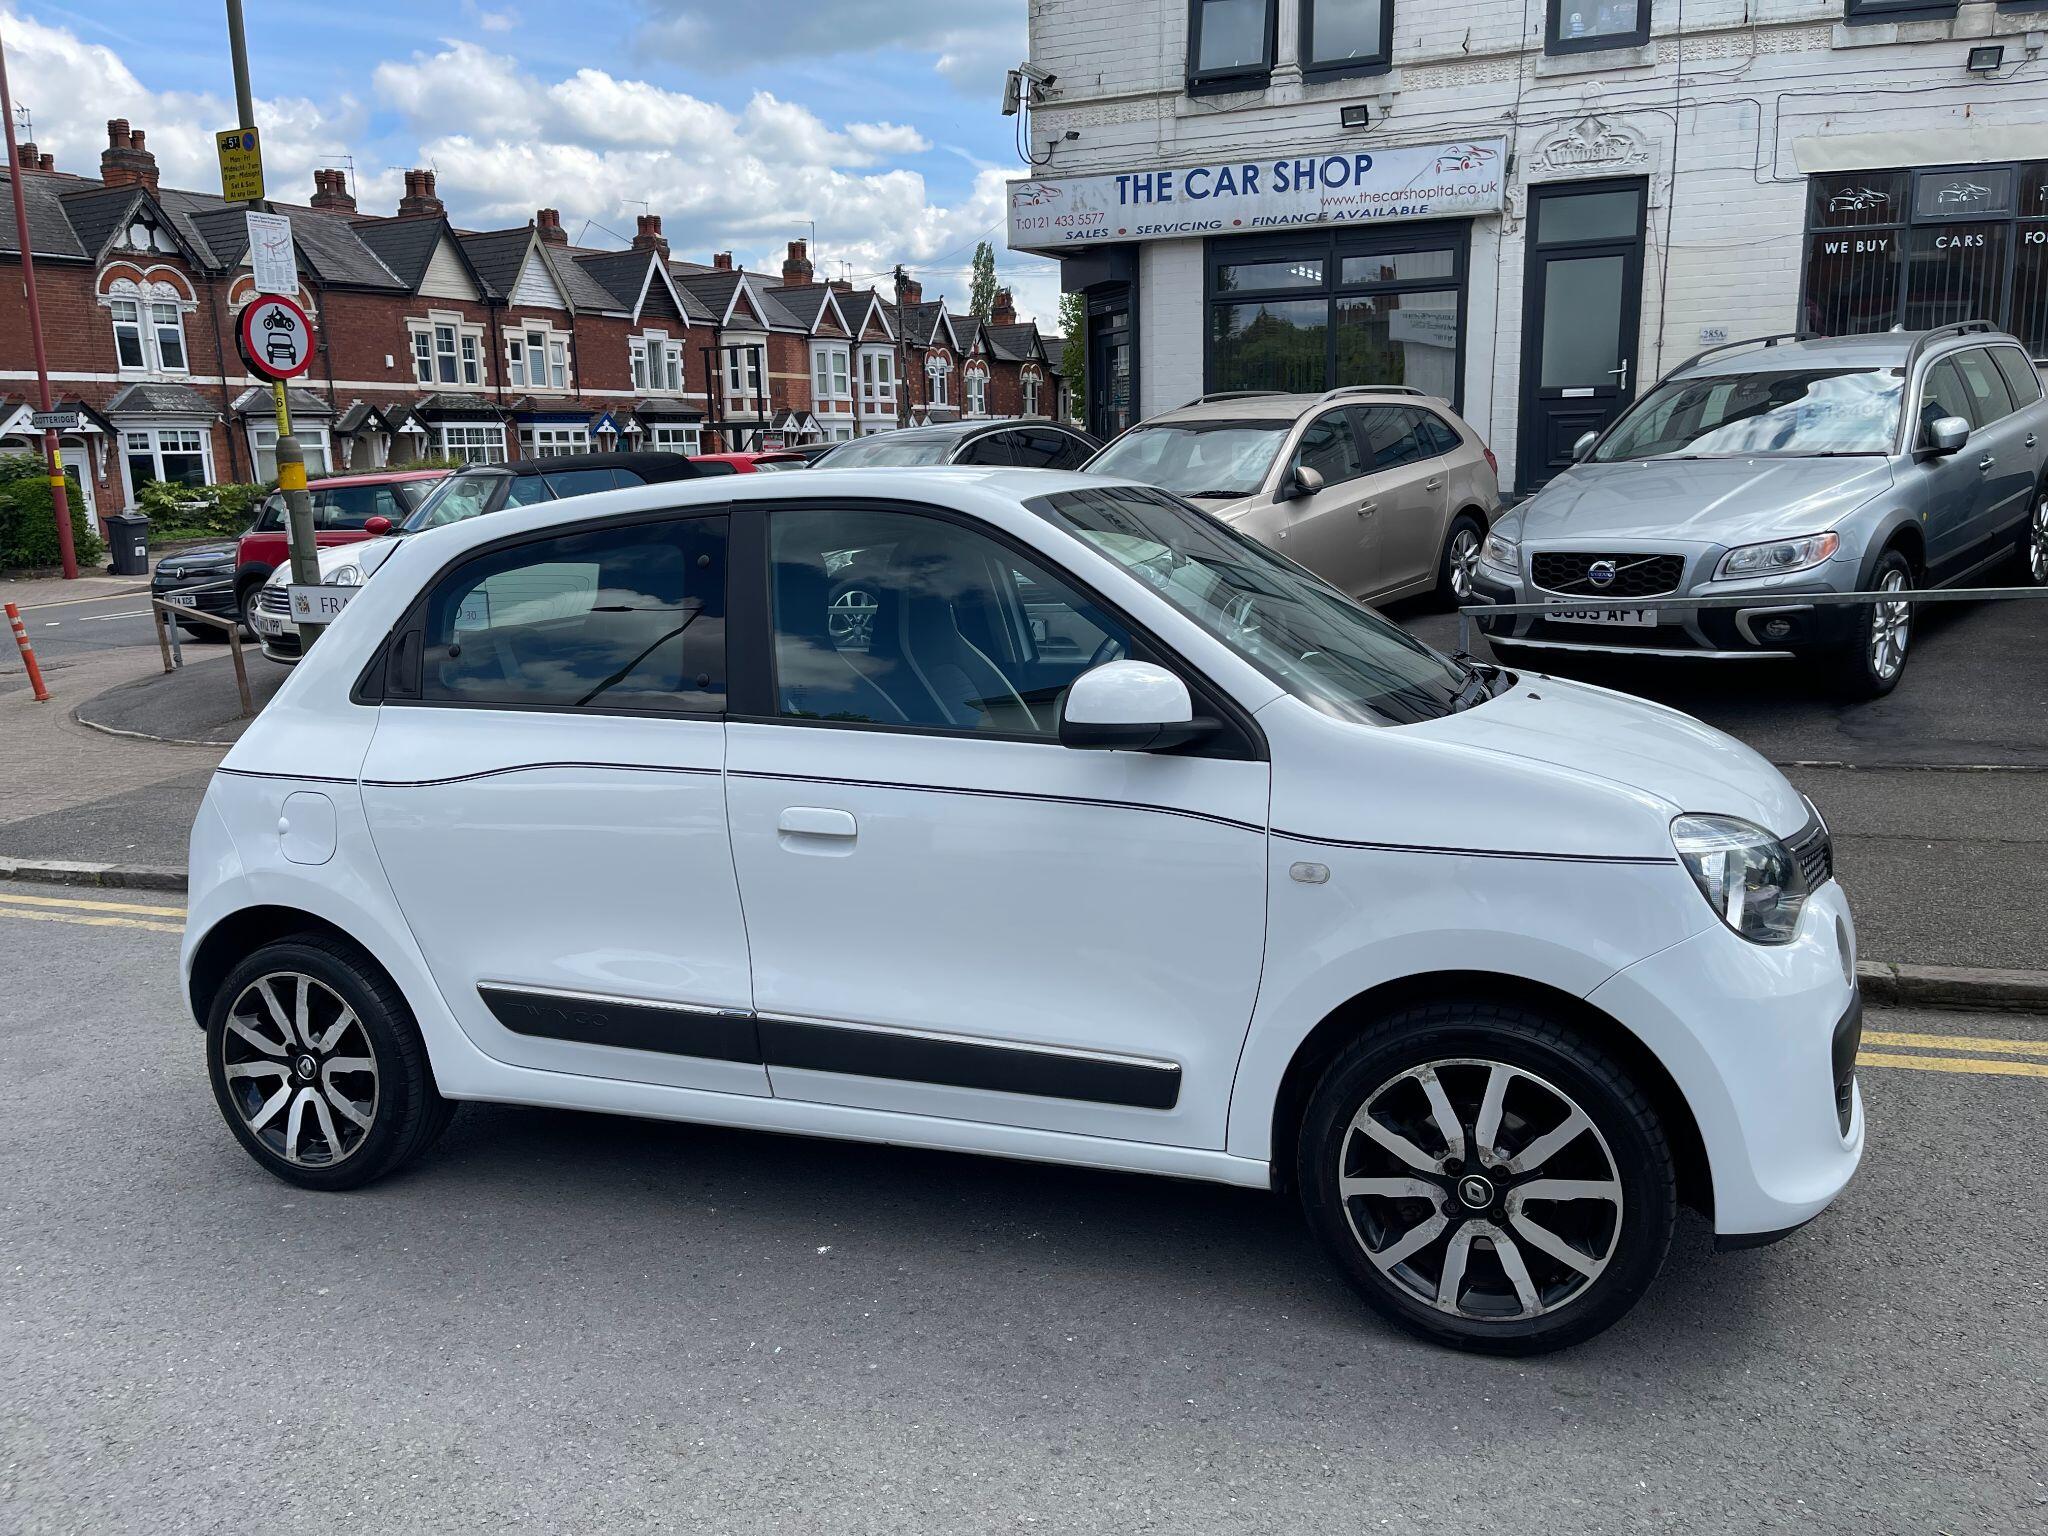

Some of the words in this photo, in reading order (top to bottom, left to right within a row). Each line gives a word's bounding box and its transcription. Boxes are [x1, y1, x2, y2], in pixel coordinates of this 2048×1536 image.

[1115, 171, 1173, 205] THE
[1184, 163, 1260, 200] CAR
[1272, 154, 1374, 193] SHOP
[1320, 180, 1497, 207] www.thecarshopltd.co.uk
[1016, 216, 1049, 230] T:0121
[1054, 214, 1074, 227] 433
[1078, 212, 1105, 225] 5577
[1065, 228, 1109, 240] SALES
[1135, 220, 1222, 235] SERVICING
[1251, 211, 1329, 227] FINANCE
[1333, 204, 1430, 221] AVAILABLE
[1825, 241, 1848, 254] WE
[1855, 239, 1889, 253] BUY
[1935, 233, 1984, 249] CARS
[2024, 231, 2048, 245] FO
